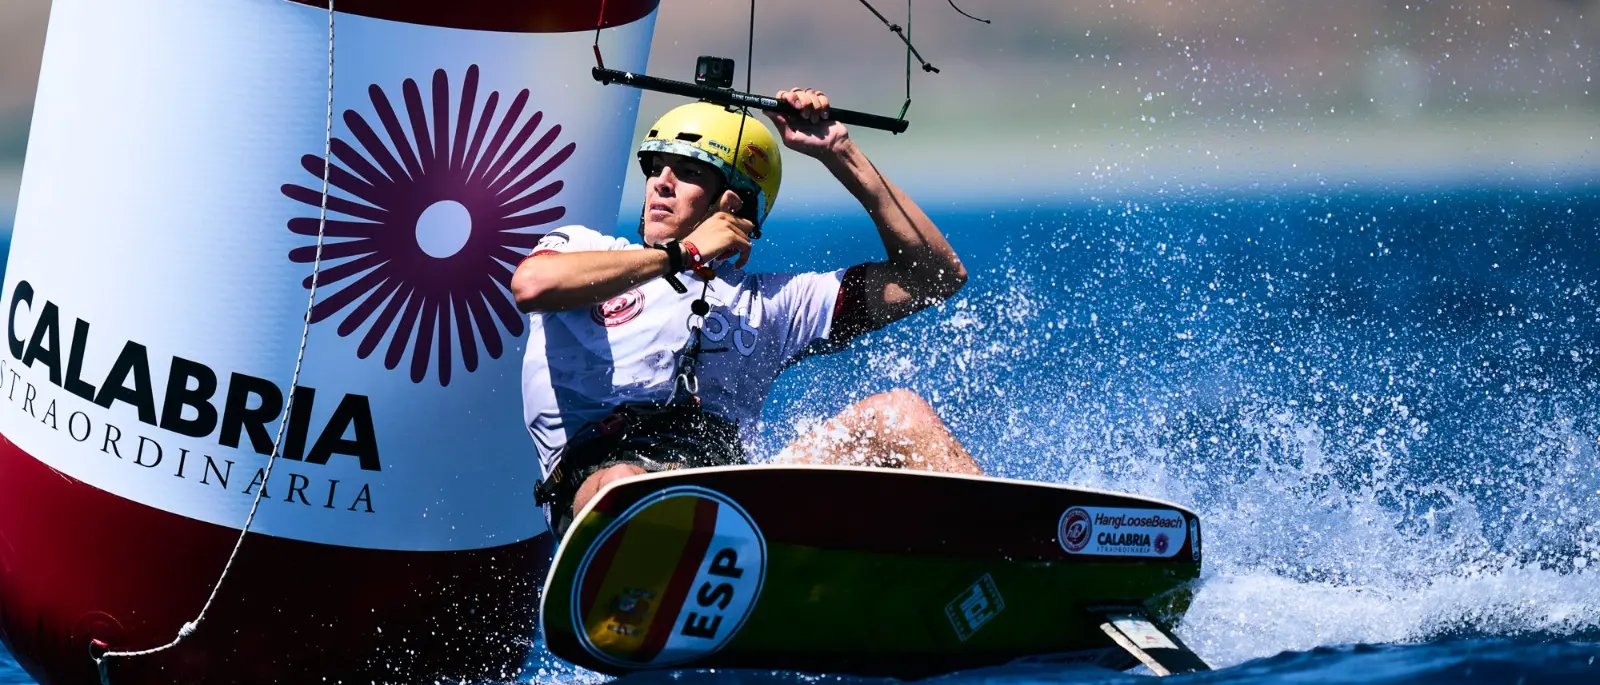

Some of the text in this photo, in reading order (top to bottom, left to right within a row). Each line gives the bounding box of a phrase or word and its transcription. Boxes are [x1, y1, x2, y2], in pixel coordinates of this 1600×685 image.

[8, 280, 381, 471] CALABRIA
[0, 359, 375, 513] STRAORDINARIA
[1094, 513, 1182, 529] HangLooseBeach
[1097, 532, 1150, 546] CALABRIA
[680, 547, 744, 640] ESP
